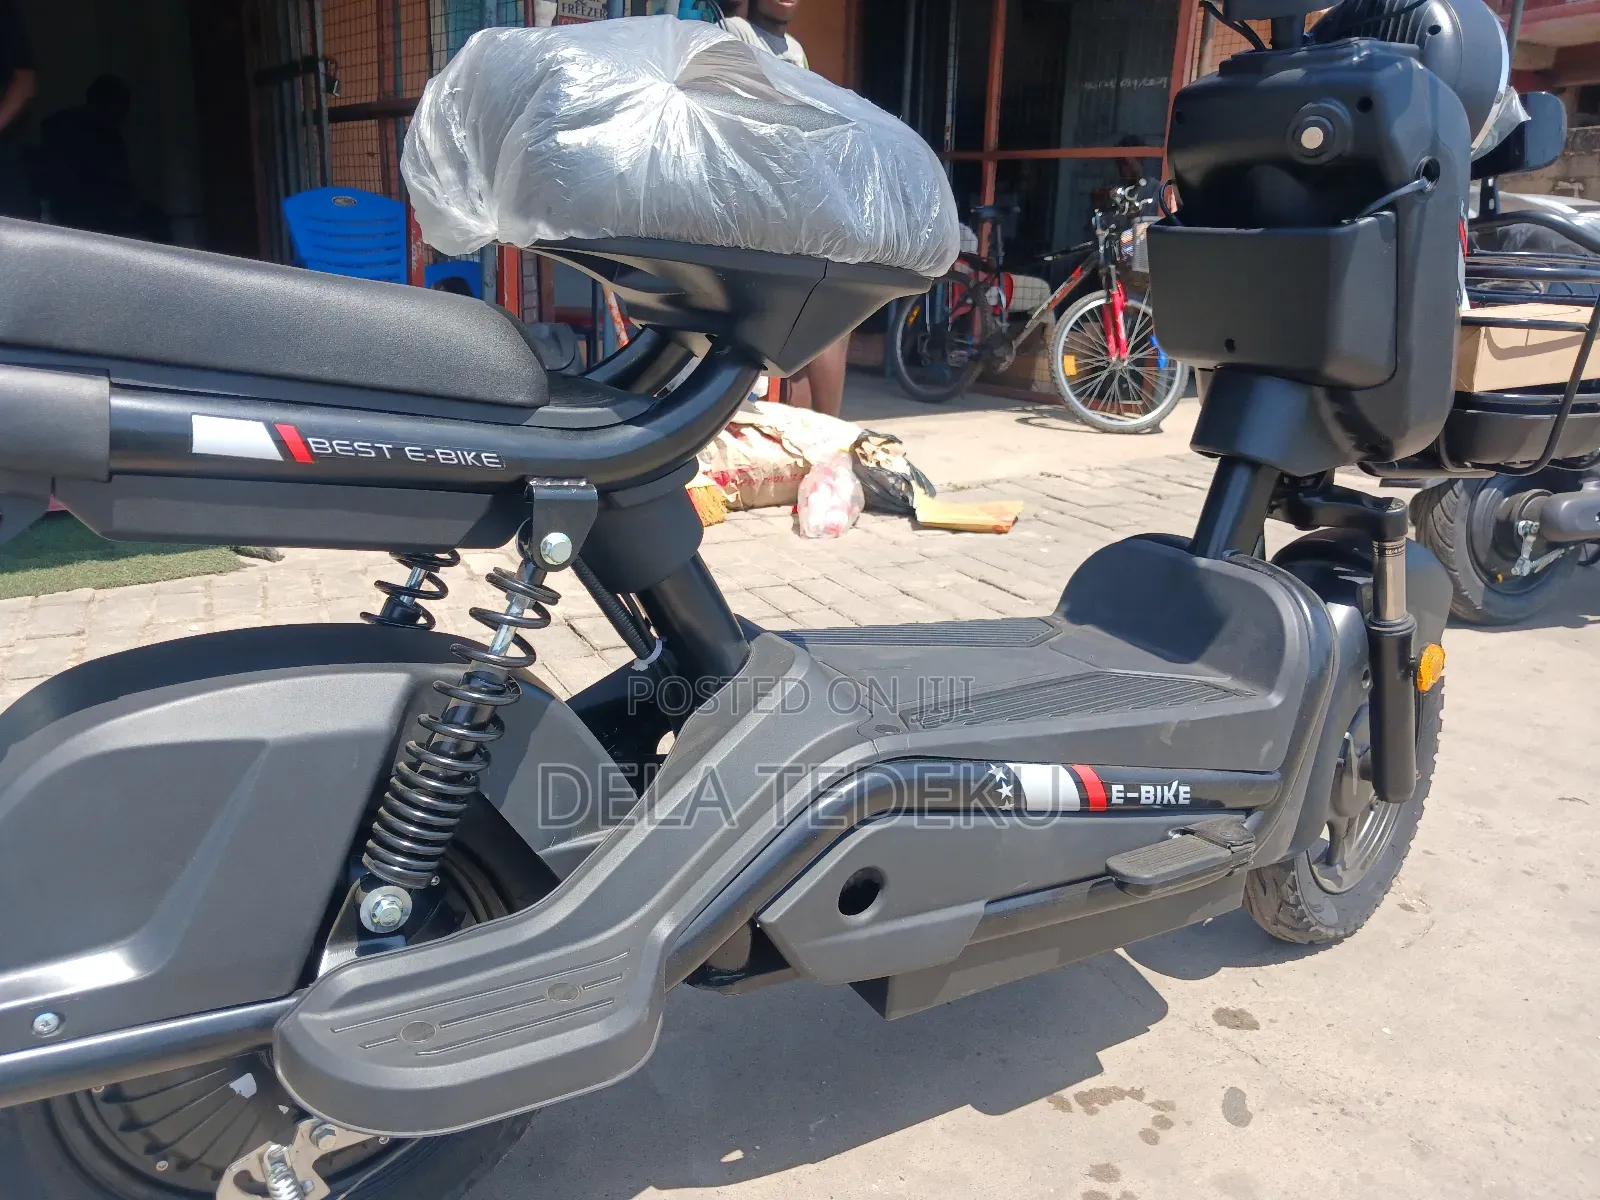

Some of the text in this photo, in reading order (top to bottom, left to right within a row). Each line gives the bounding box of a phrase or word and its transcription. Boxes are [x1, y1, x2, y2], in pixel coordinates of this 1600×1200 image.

[561, 2, 608, 20] FREEZER
[307, 437, 502, 468] BEST E-BIKE
[1110, 779, 1191, 805] E-BIKE
